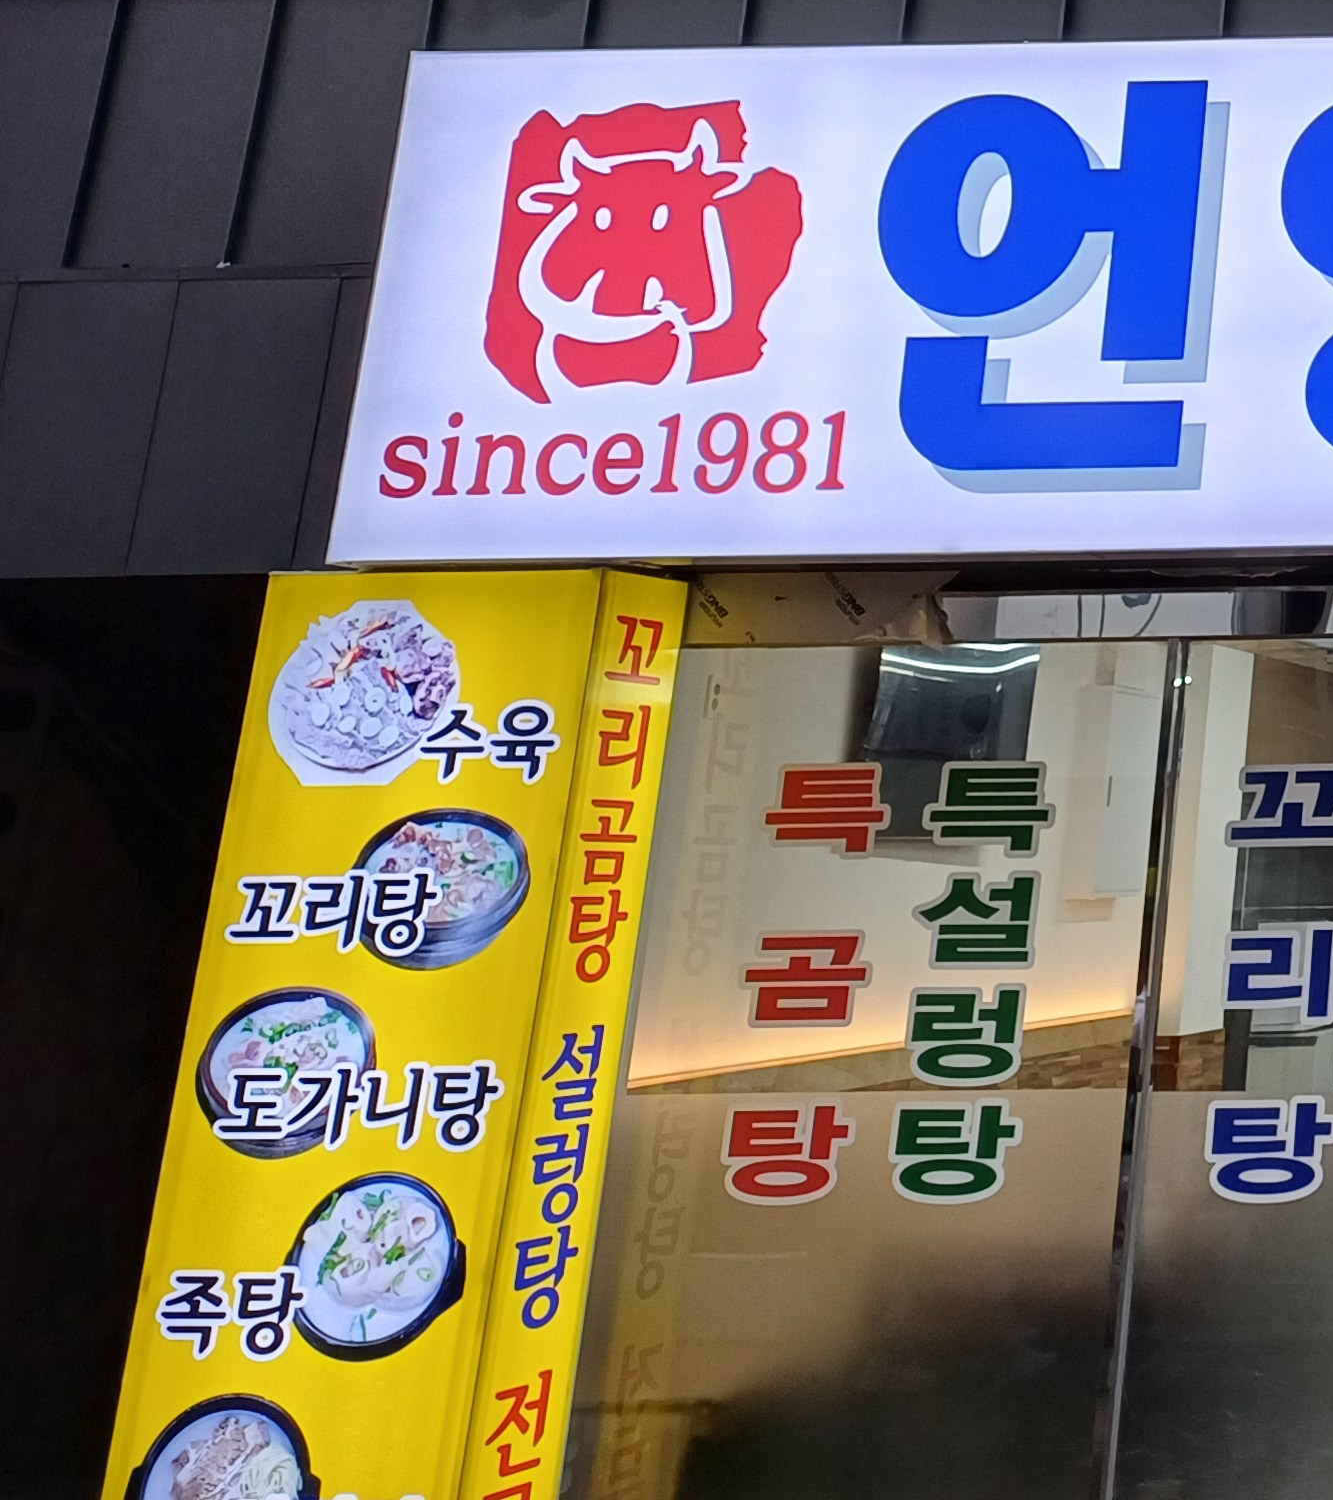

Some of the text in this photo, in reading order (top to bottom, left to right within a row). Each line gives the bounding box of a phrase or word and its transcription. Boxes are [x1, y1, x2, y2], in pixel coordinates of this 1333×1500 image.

[379, 410, 847, 499] since1981
[420, 705, 557, 781] 수육
[228, 874, 442, 952] 꼬리탕
[893, 766, 1051, 1197] 특설렁탕
[485, 614, 665, 1500] 꼬리곰탕 설렁탕 전
[217, 1065, 500, 1146] 도가니탕
[161, 1271, 305, 1357] 족탕
